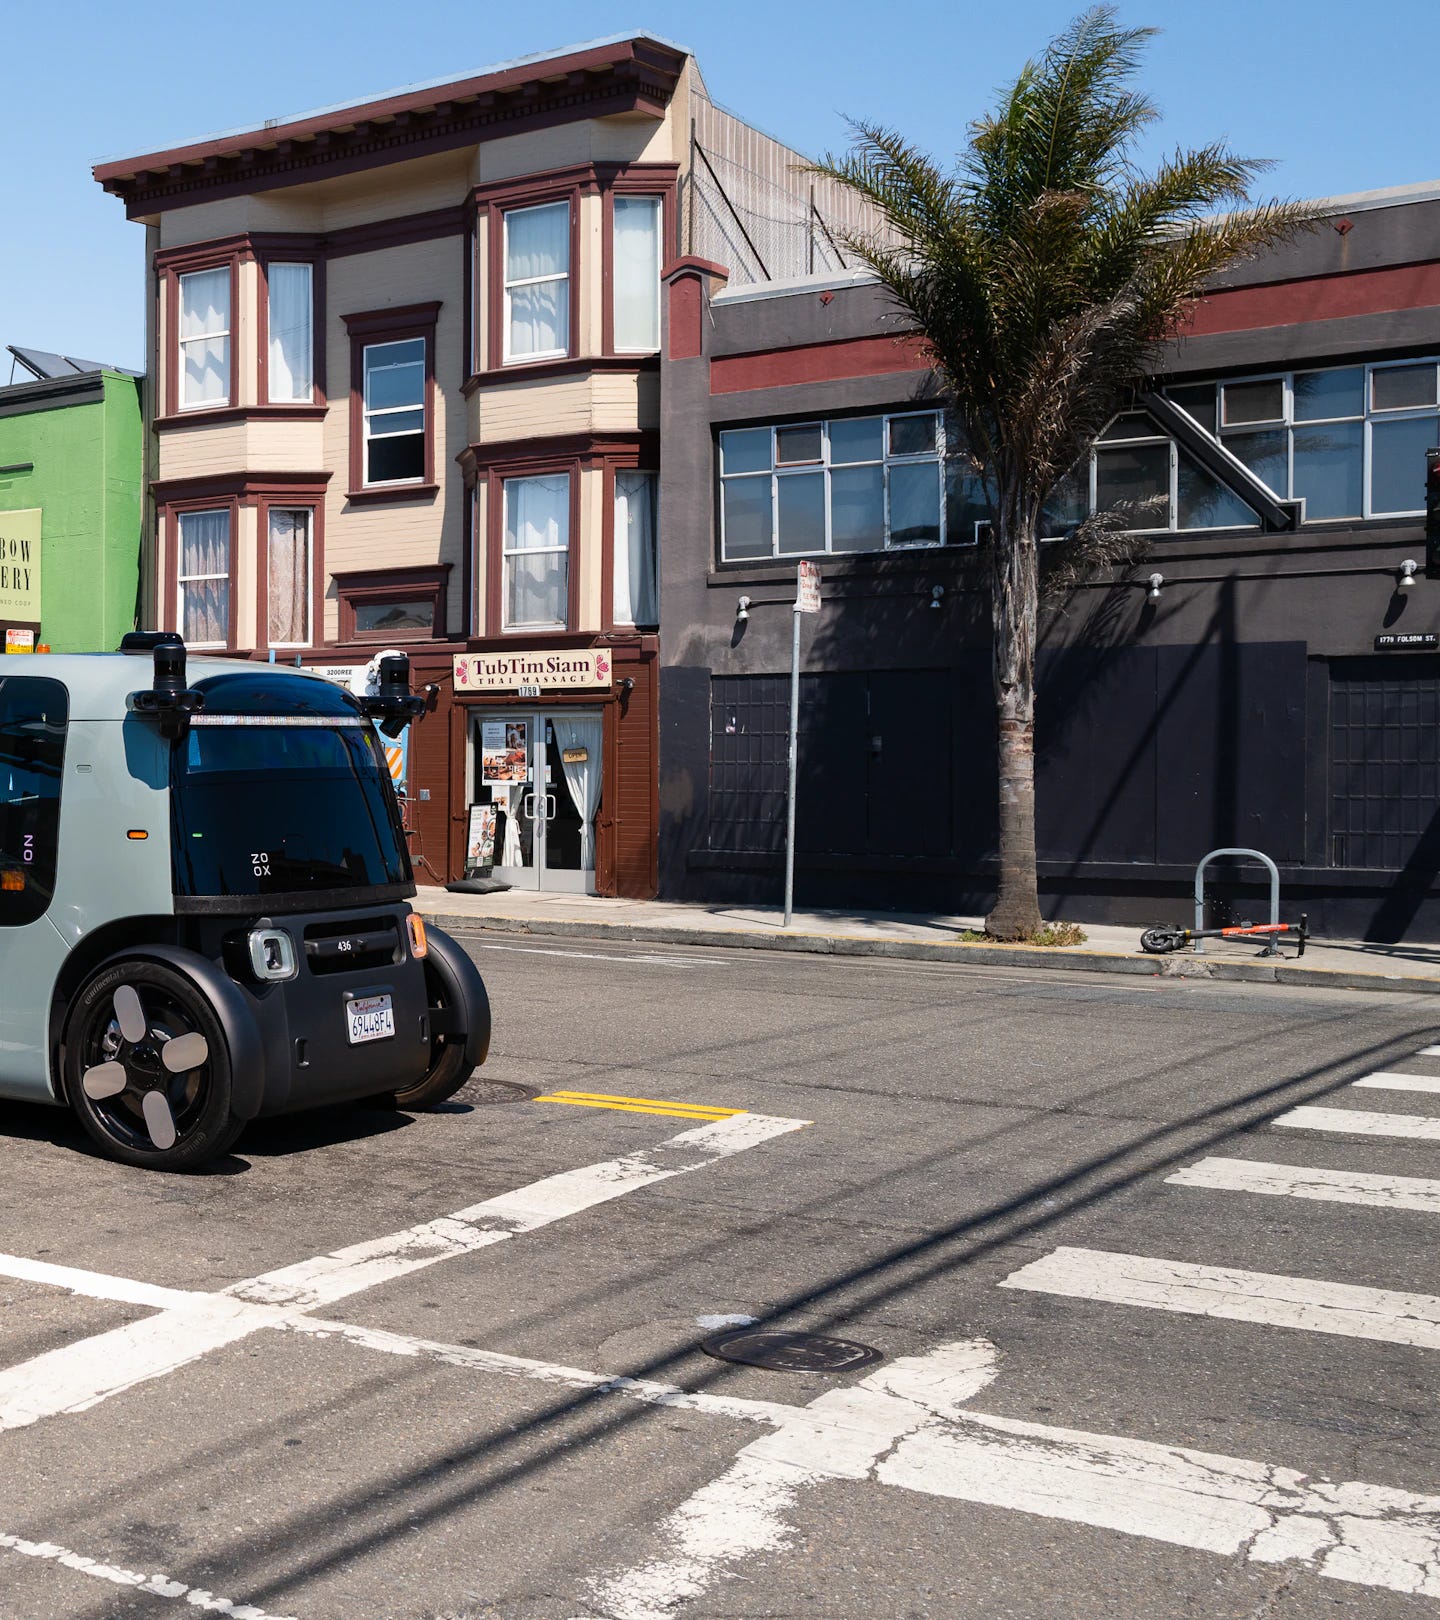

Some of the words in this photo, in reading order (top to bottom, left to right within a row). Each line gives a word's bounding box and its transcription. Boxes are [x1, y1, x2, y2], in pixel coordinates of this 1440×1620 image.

[1397, 635, 1423, 643] FOLSOM
[479, 677, 513, 685] THAI
[522, 675, 587, 684] MASSAGE
[337, 940, 352, 952] 436
[352, 1011, 392, 1039] 69448F4
